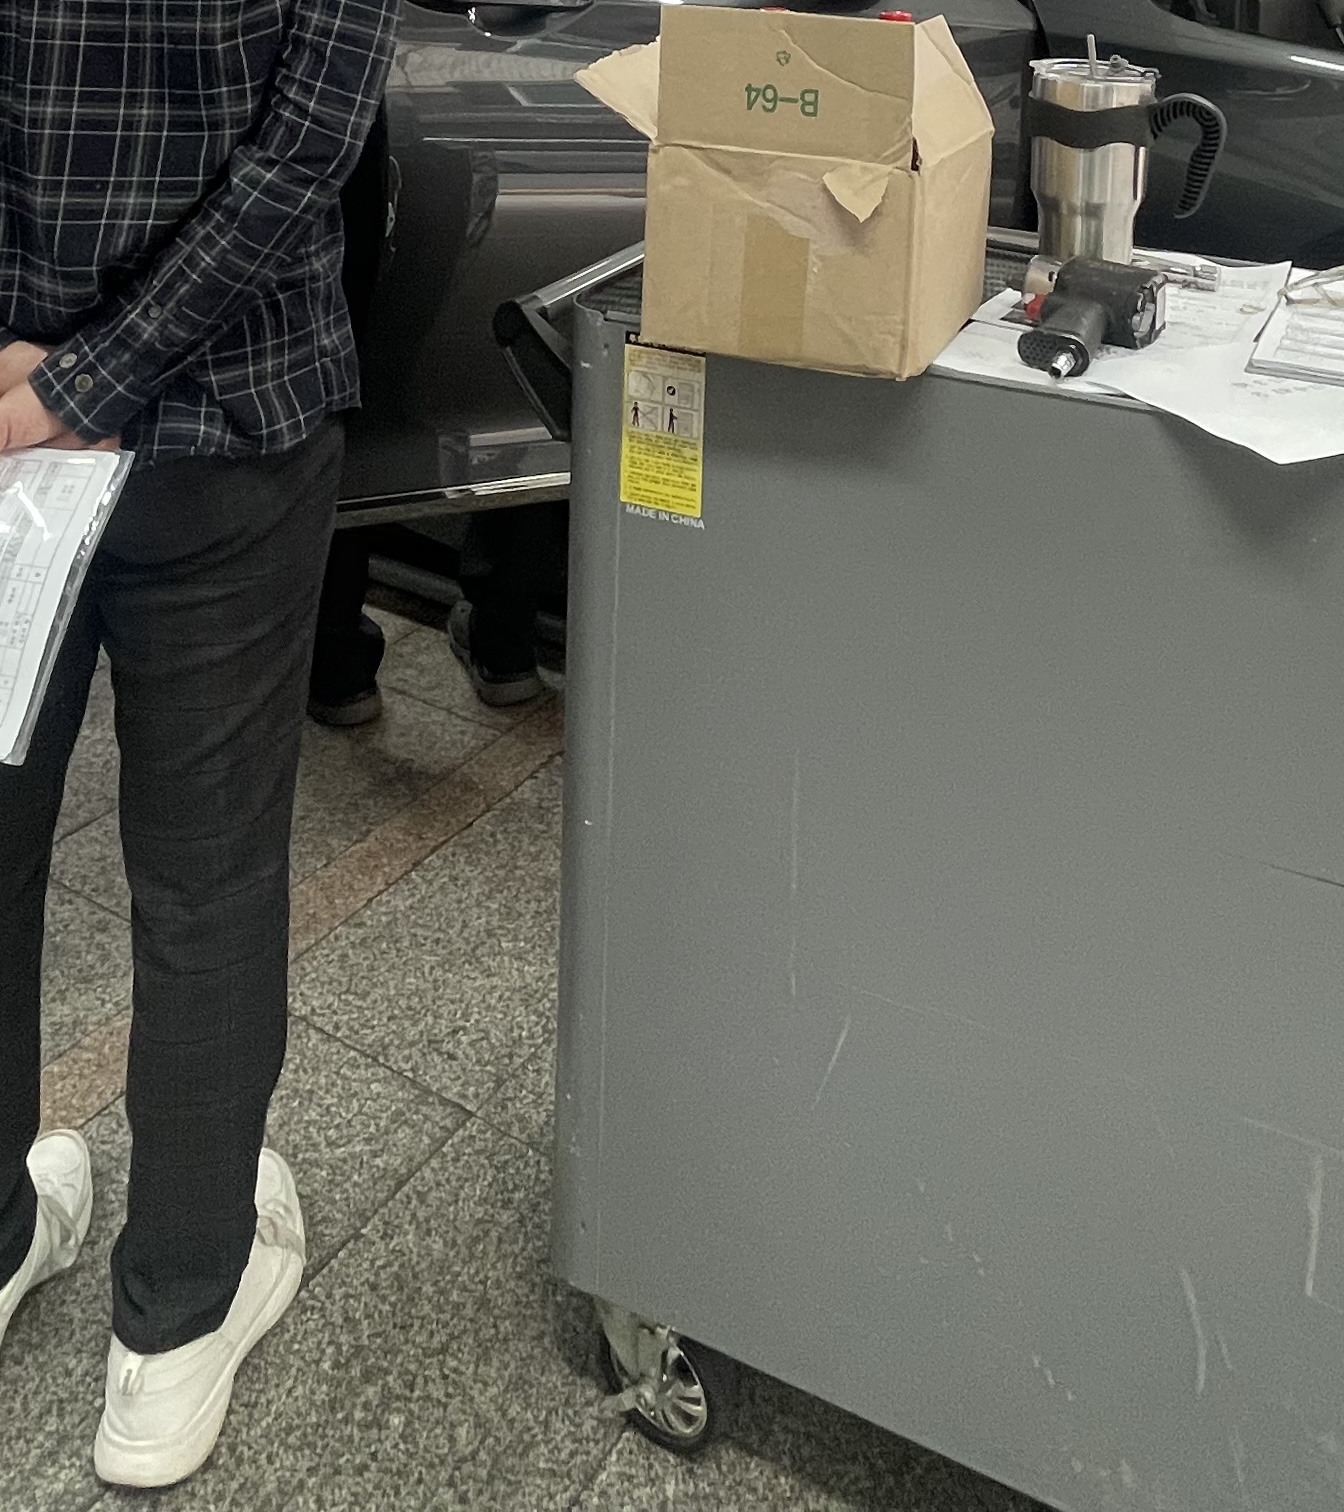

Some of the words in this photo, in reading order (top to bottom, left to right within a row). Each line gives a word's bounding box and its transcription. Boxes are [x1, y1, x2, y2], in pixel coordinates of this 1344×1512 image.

[744, 82, 819, 118] B-64
[625, 504, 657, 519] MADE
[658, 511, 670, 522] IN
[671, 514, 705, 531] CHINA
